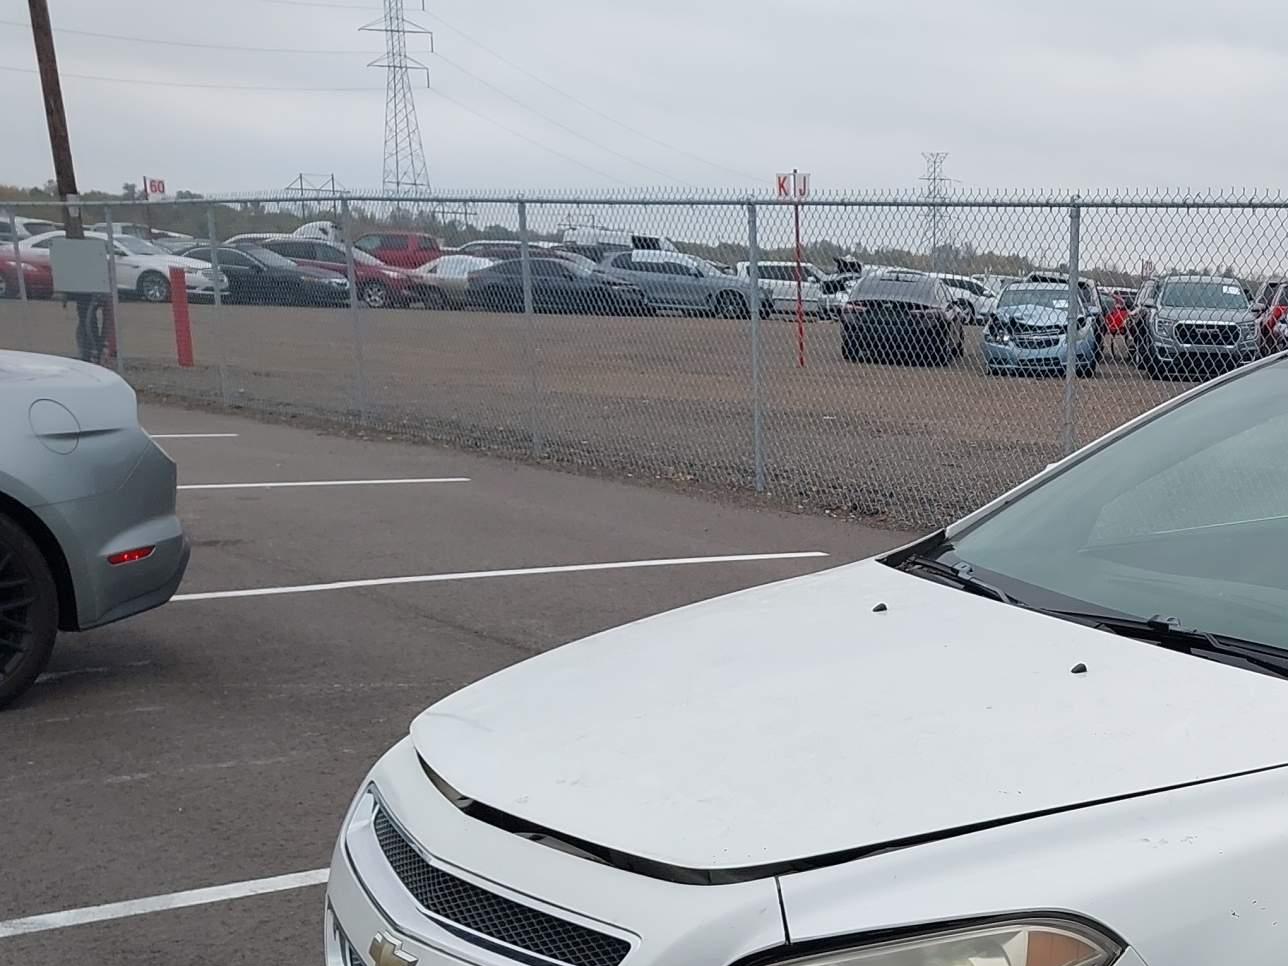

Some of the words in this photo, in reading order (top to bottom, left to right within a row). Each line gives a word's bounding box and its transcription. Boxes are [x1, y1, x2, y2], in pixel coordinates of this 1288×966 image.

[149, 179, 165, 194] 60
[777, 175, 789, 197] K
[798, 175, 807, 197] J
